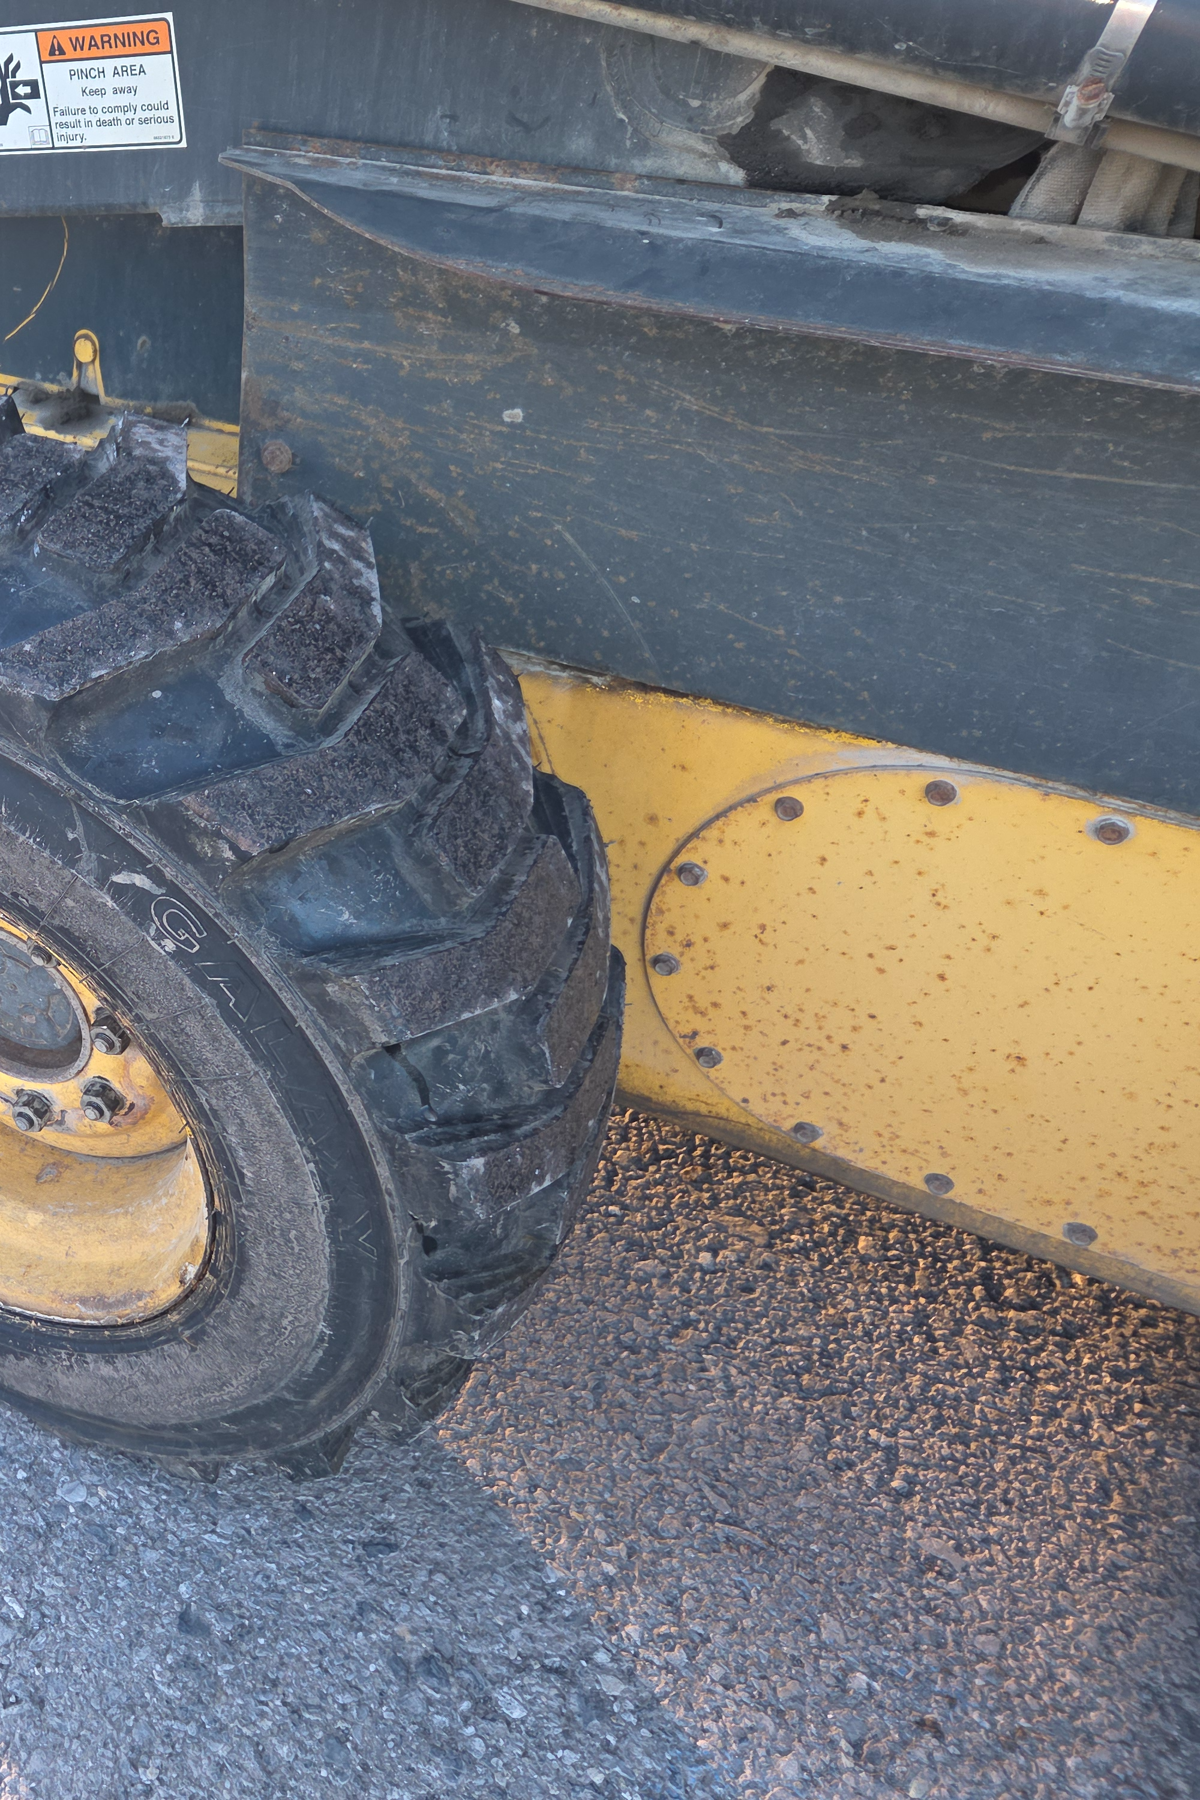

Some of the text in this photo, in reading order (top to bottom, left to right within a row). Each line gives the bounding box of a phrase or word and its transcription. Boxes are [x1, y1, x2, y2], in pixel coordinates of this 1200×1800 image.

[68, 29, 160, 52] WARNING
[69, 64, 146, 81] PINCH AREA
[81, 86, 138, 99] Keep away
[53, 100, 169, 117] Failure to comply could
[55, 114, 174, 129] result in death or serious
[56, 132, 87, 144] injury.
